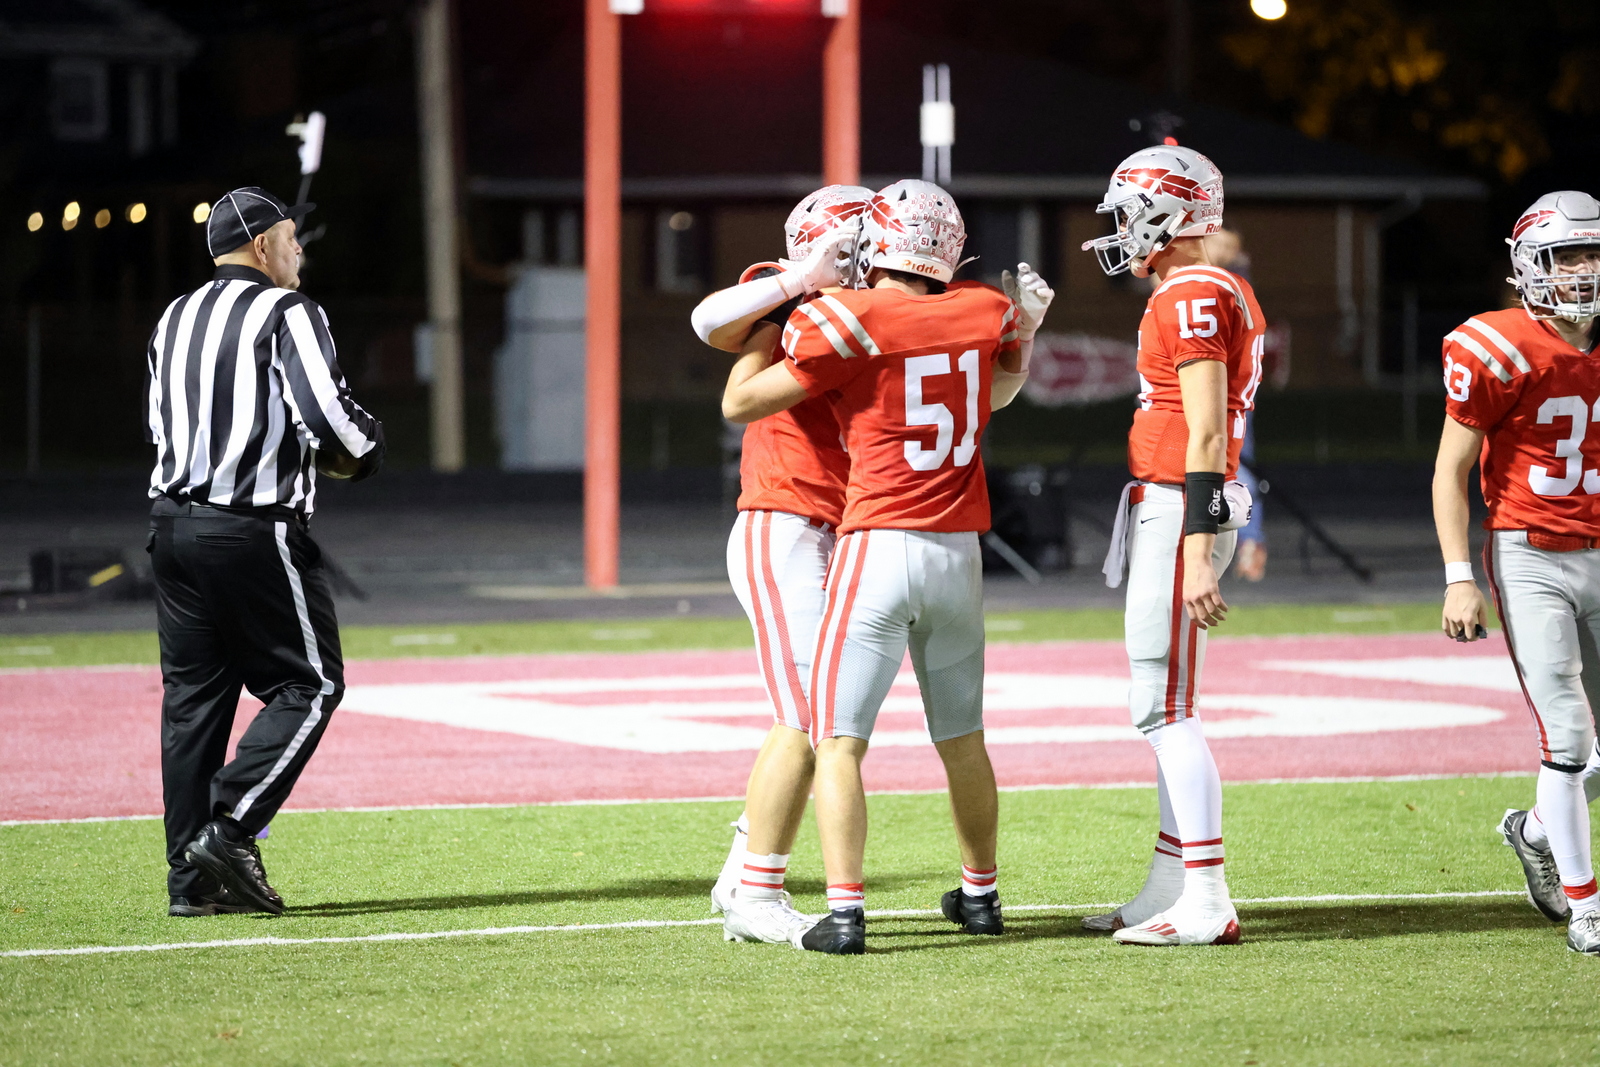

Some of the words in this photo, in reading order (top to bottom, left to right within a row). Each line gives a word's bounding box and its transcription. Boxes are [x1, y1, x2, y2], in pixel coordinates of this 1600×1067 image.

[920, 237, 930, 246] 51
[1175, 298, 1218, 339] 15
[903, 349, 980, 471] 51
